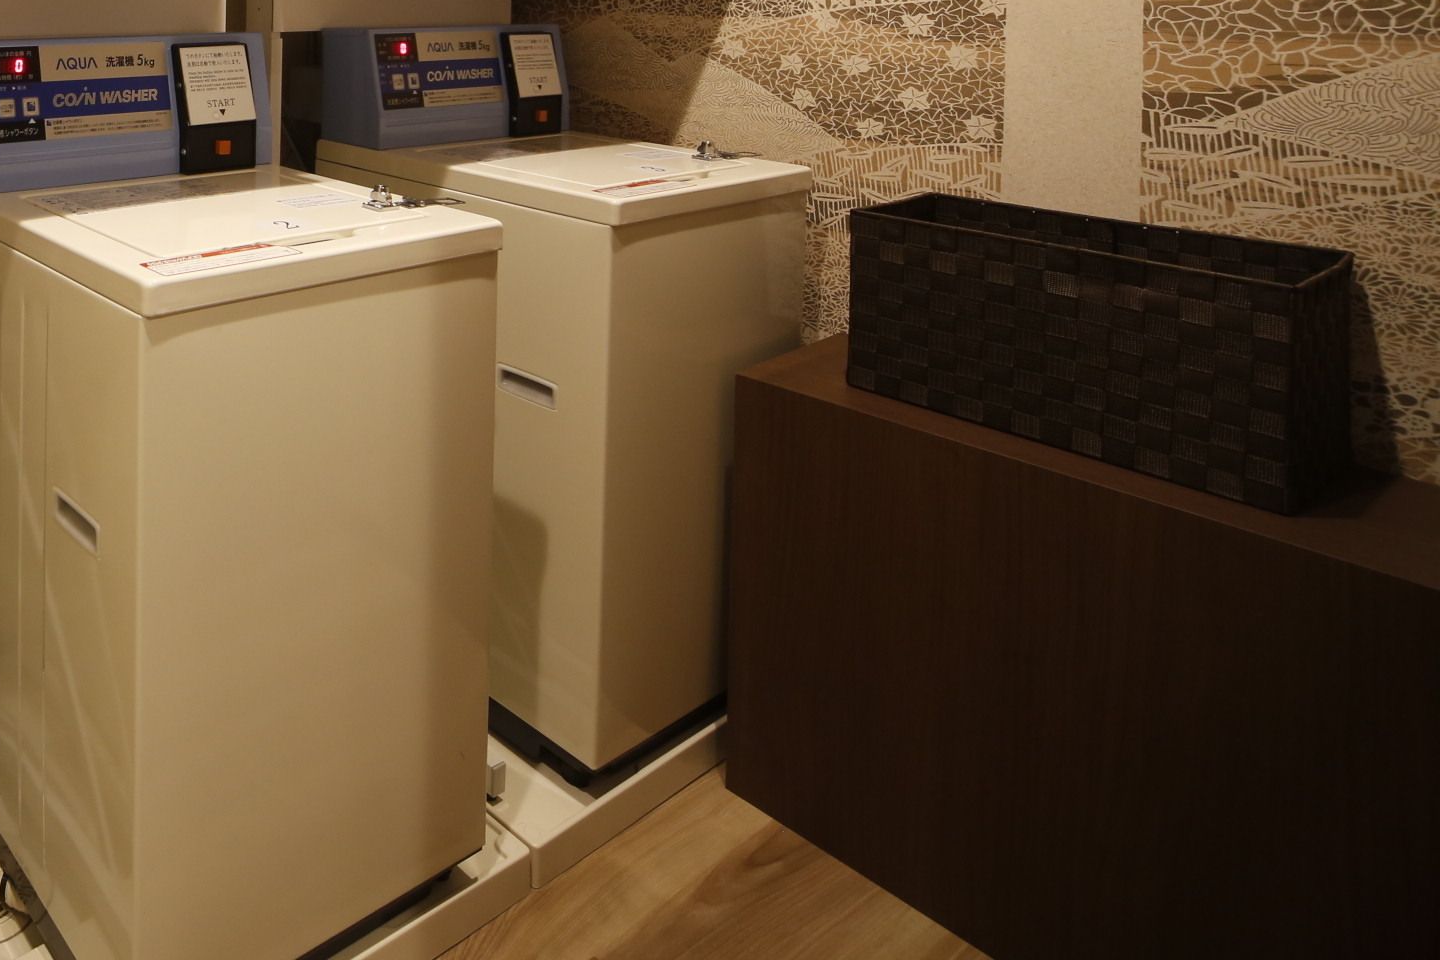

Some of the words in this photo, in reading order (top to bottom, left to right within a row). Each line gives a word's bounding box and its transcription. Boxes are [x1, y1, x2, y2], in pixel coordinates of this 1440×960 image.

[427, 42, 454, 52] AQUA
[15, 59, 24, 73] 0
[56, 56, 98, 71] AQUA
[105, 55, 135, 68] 洗濯機
[137, 54, 155, 68] 5kg
[456, 68, 495, 80] WASHER
[100, 88, 158, 104] WASHER
[206, 97, 236, 108] START
[272, 220, 299, 230] 2
